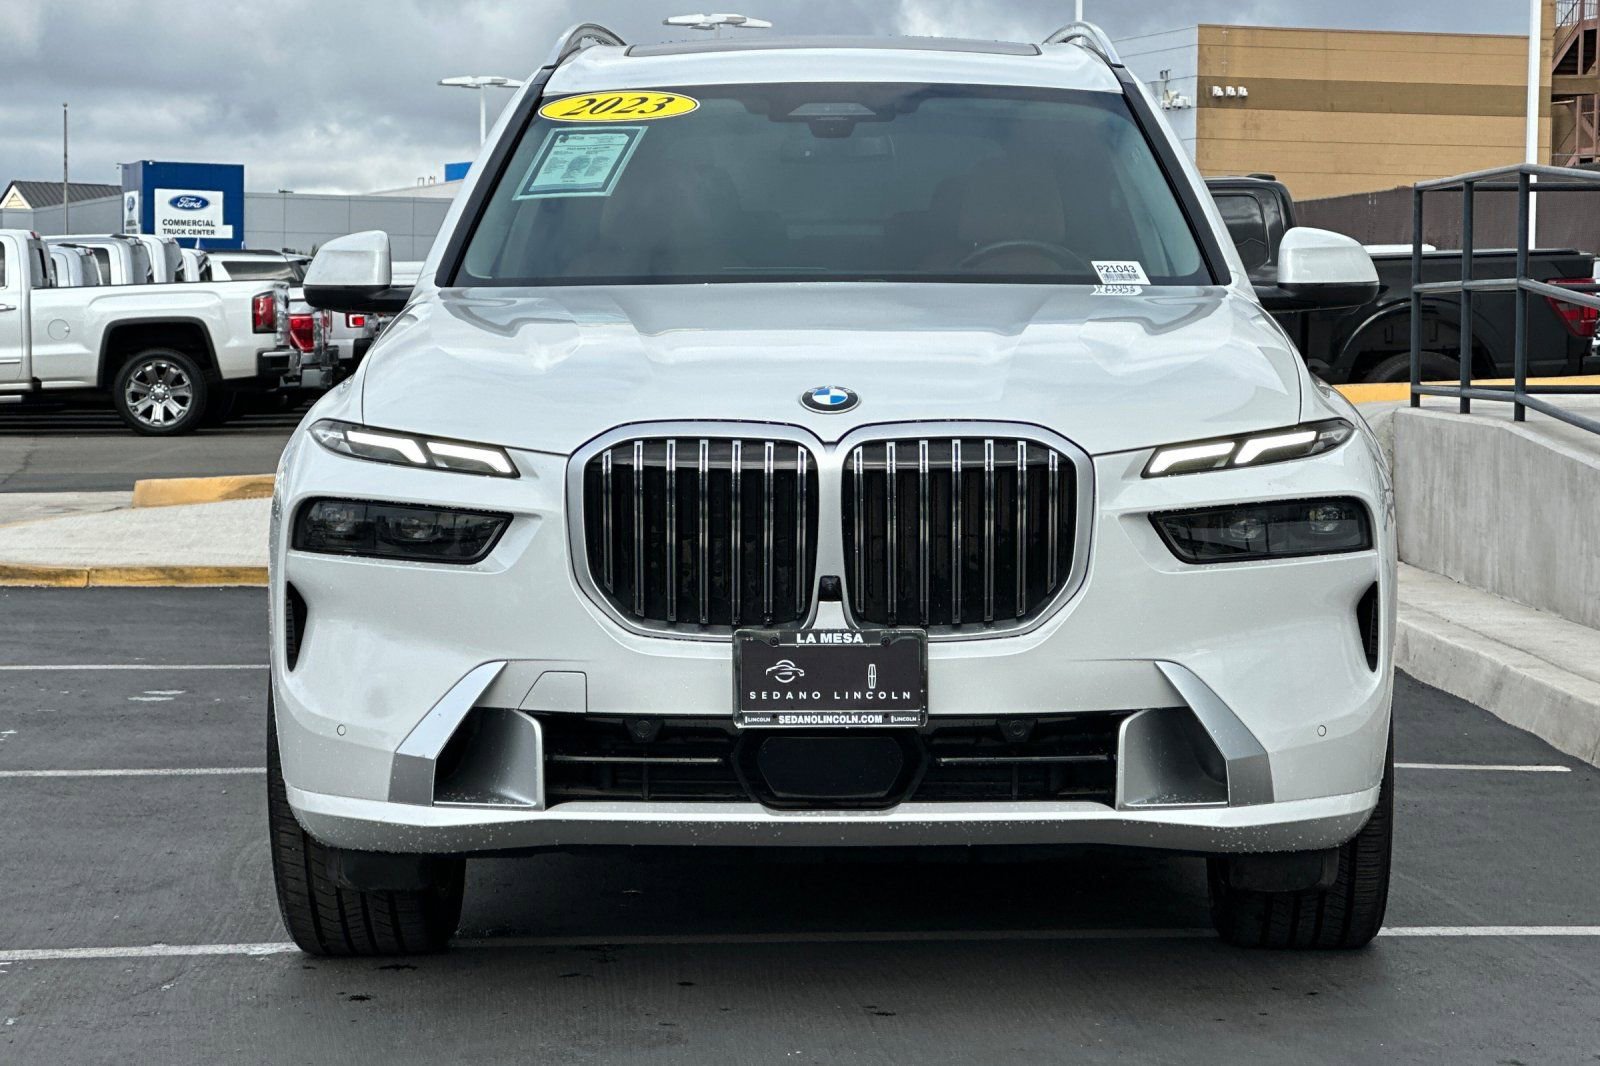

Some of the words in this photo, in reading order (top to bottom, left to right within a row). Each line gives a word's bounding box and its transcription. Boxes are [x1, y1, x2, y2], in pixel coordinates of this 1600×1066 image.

[560, 96, 675, 117] 2023
[177, 196, 202, 208] Ford
[162, 218, 216, 227] COMMERCIAL
[163, 228, 186, 236] TRUCK
[188, 228, 215, 236] CENTER
[1096, 264, 1137, 273] P21043
[796, 633, 816, 643] LA
[820, 633, 863, 643] MESA
[750, 691, 821, 700] SEDANO
[834, 691, 911, 700] LINCOLN
[778, 714, 883, 724] SEDANOLINCOLN.COM
